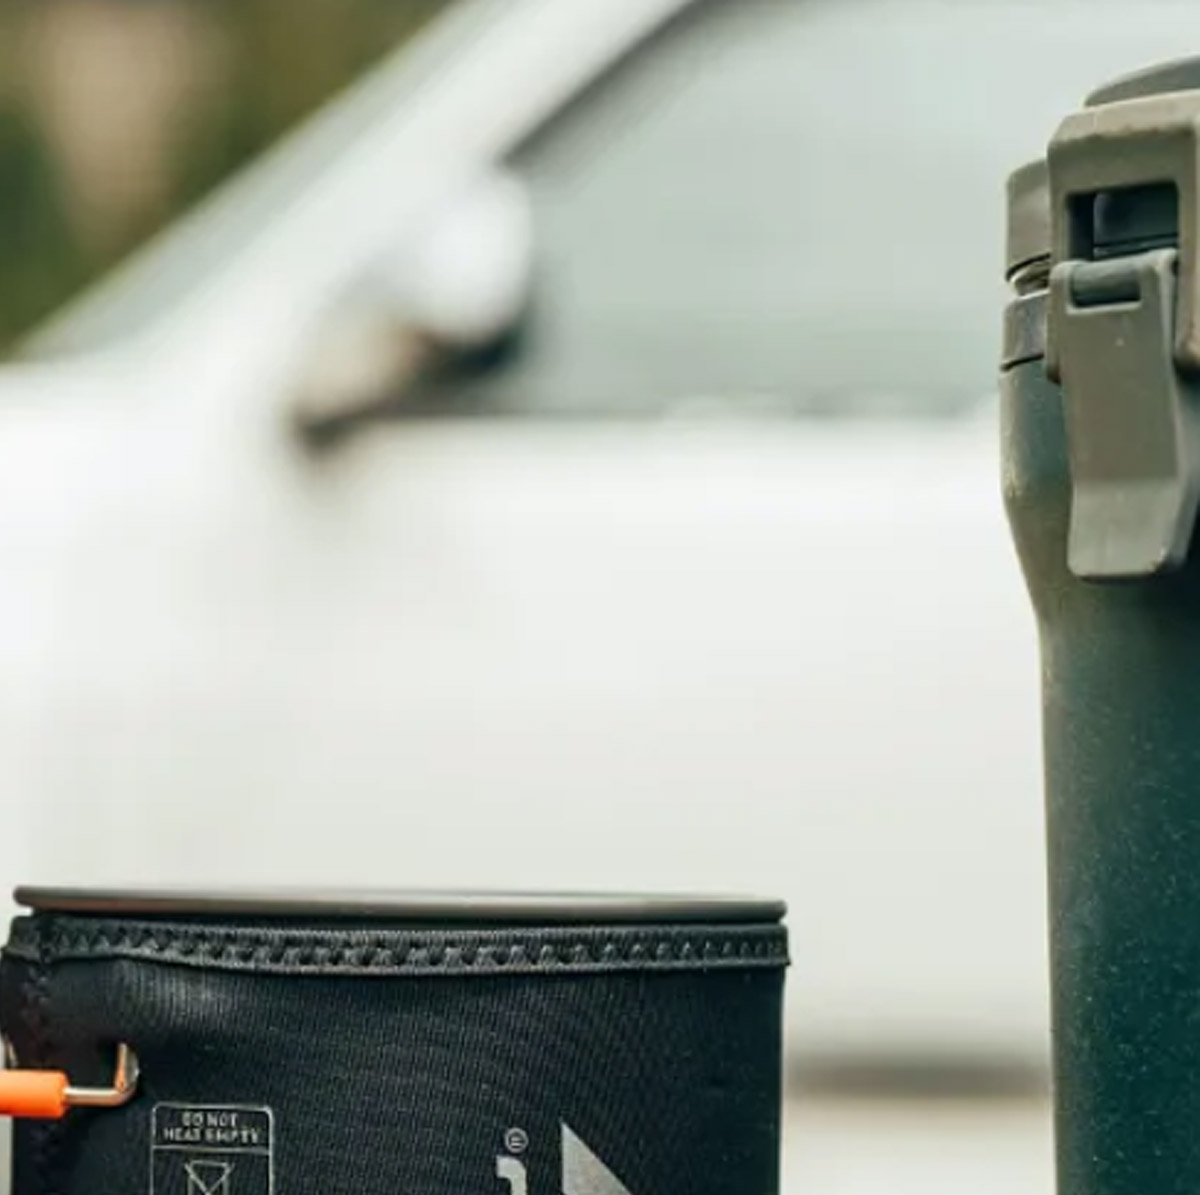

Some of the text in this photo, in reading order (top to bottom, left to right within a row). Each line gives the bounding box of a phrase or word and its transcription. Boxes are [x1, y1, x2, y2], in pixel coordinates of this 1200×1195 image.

[182, 1112, 237, 1128] DO NOT
[164, 1127, 259, 1144] HEAT EMPTY
